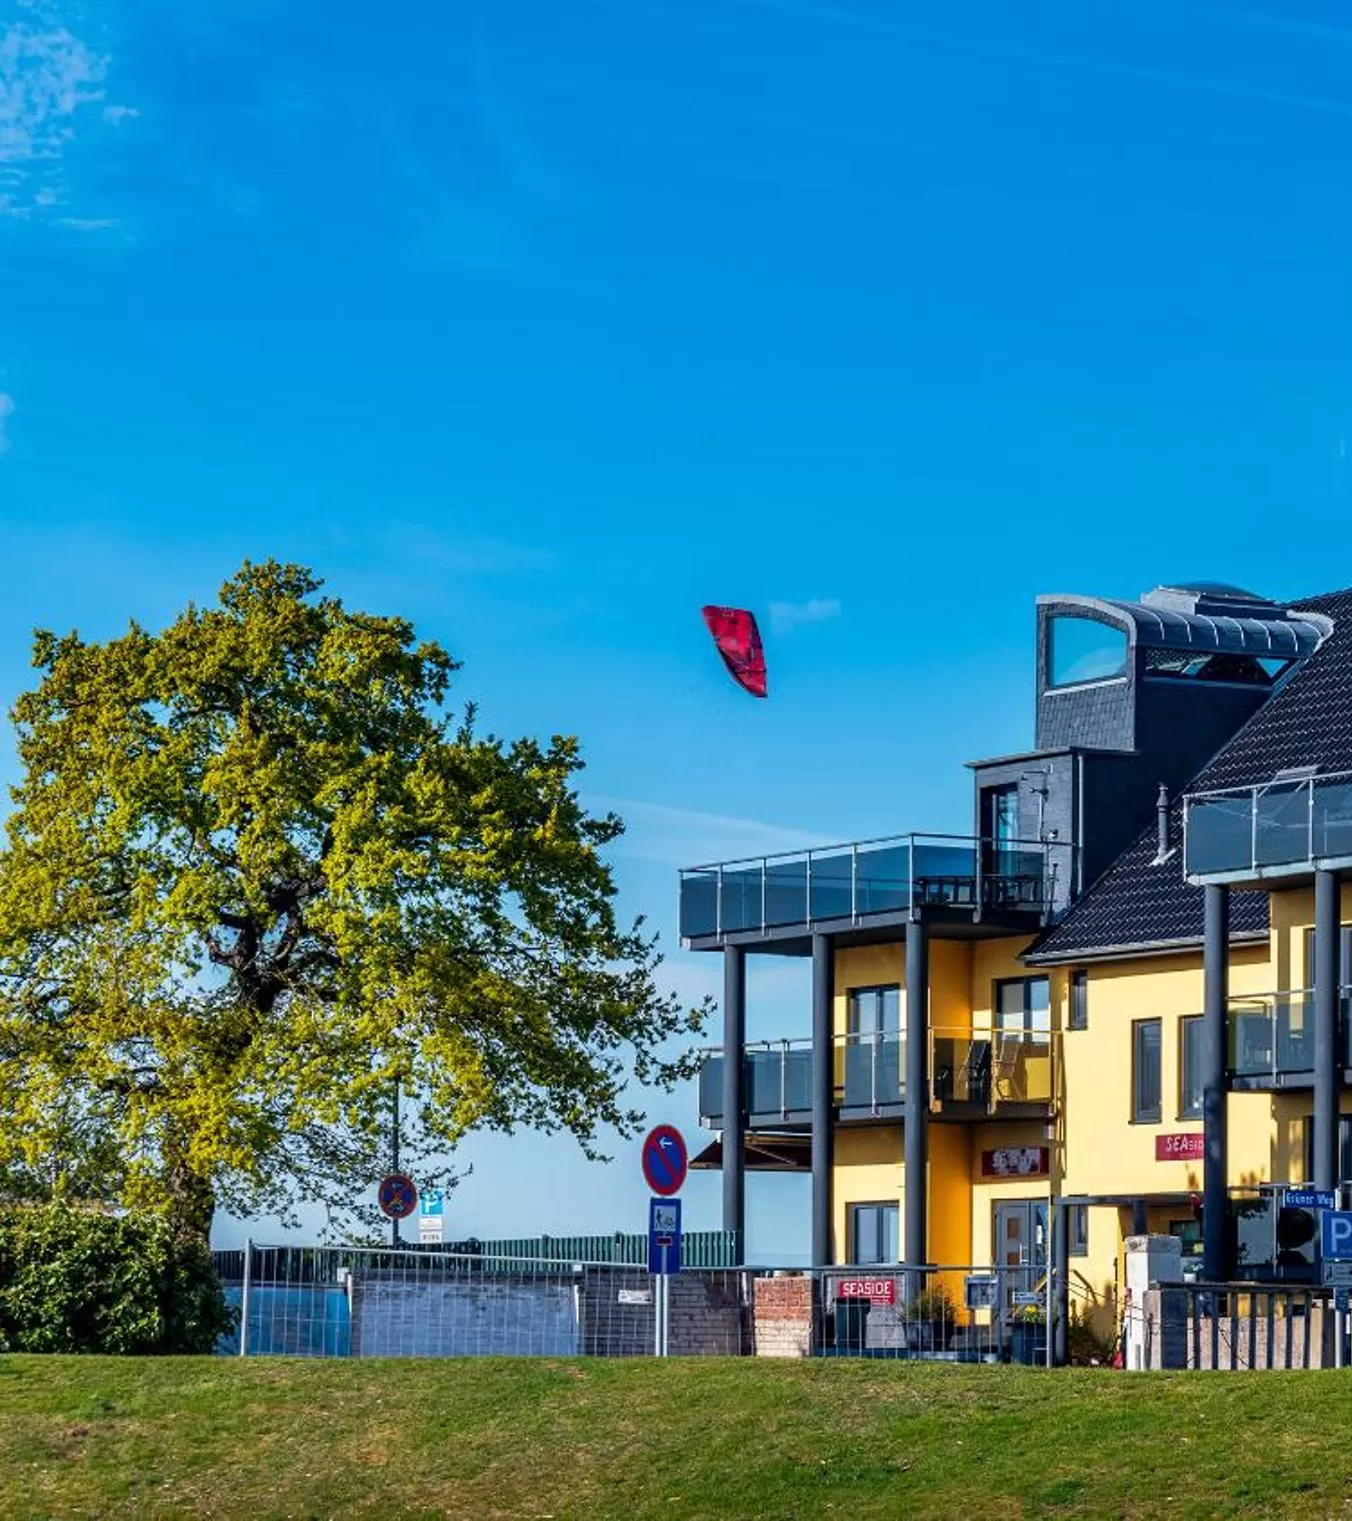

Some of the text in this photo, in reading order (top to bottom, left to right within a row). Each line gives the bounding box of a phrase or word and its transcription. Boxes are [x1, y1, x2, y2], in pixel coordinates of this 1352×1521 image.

[1165, 1135, 1204, 1152] SEASID
[1317, 1193, 1334, 1208] Weg
[1331, 1217, 1352, 1253] P
[842, 1281, 892, 1296] SEASIDE
